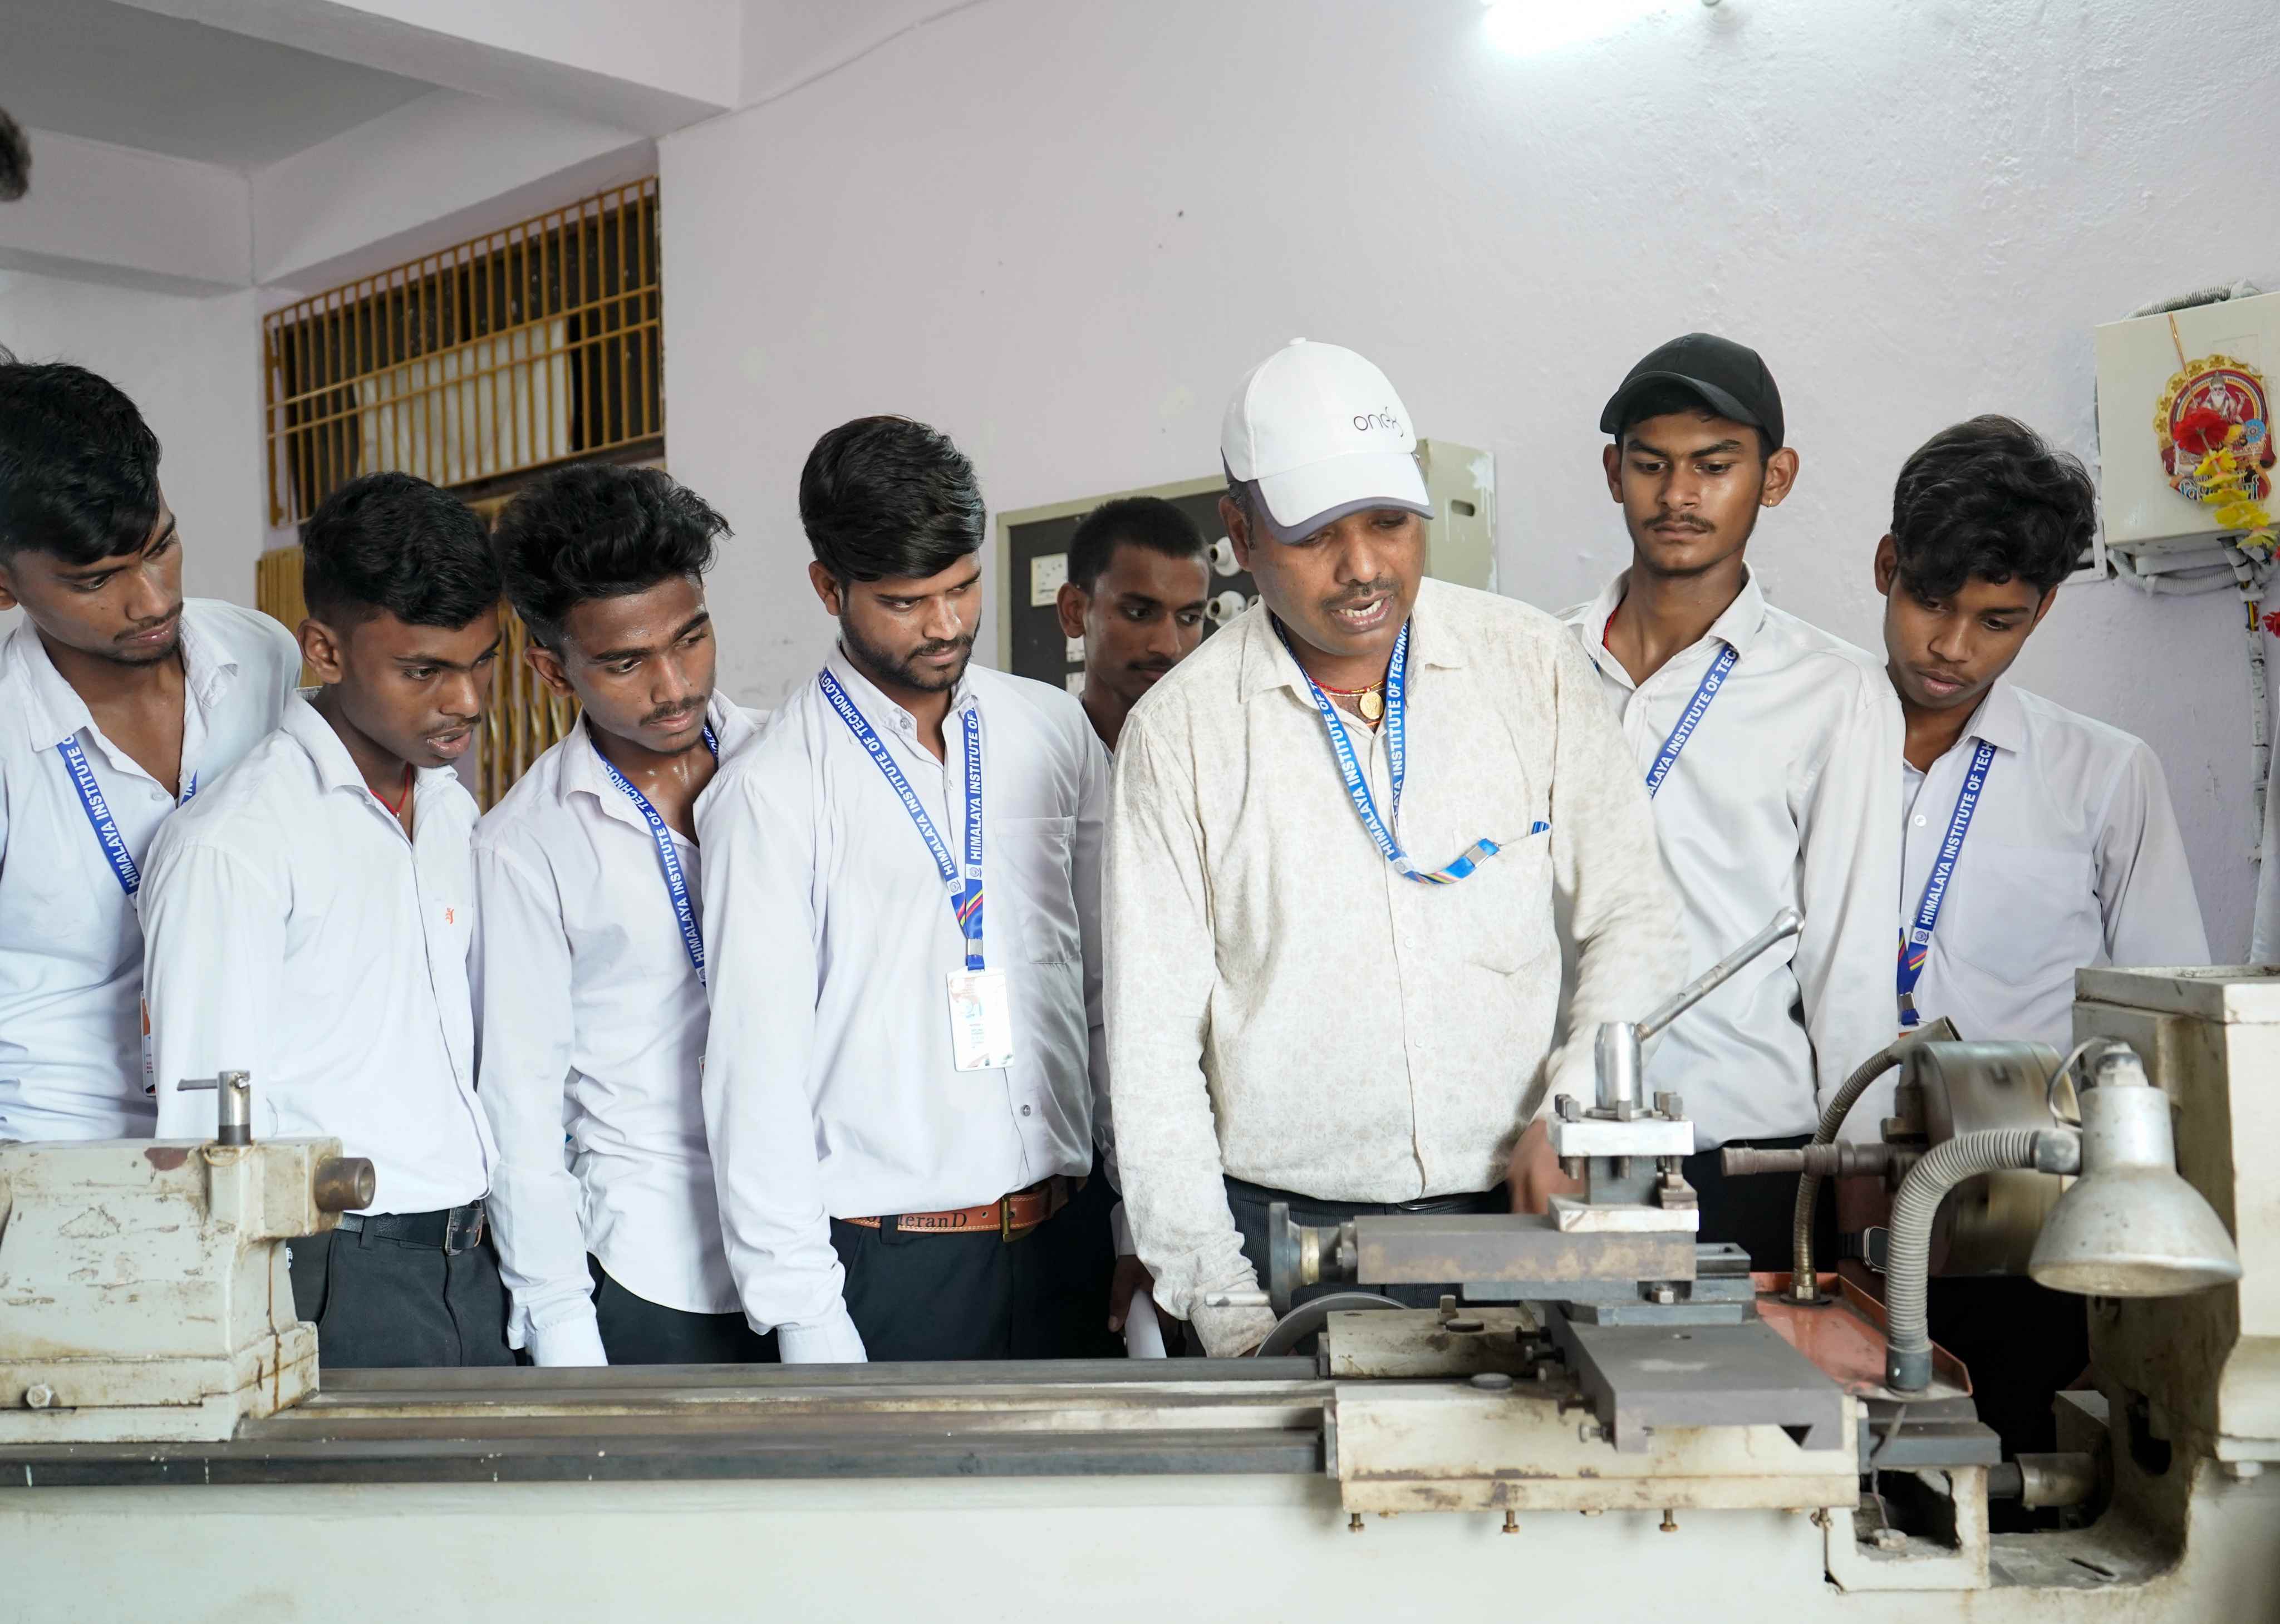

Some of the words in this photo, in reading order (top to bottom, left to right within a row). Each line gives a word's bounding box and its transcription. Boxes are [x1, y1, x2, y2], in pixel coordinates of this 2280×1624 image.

[967, 713, 978, 729] OF
[1314, 693, 1329, 710] OF
[1388, 681, 1401, 698] OF
[1667, 692, 1711, 755] INSTITUTE
[1706, 673, 1721, 692] OF
[863, 736, 880, 752] OF
[968, 731, 981, 796] INSTITUTE
[1325, 713, 1361, 785] INSTITUTE
[1388, 700, 1403, 776] INSTITUTE
[67, 746, 110, 820] INSTITUTE
[875, 751, 921, 814] INSTITUTE
[646, 811, 661, 825] OF
[916, 813, 955, 875] HIMALAYA
[970, 798, 982, 860] HIMALAYA
[1353, 786, 1394, 855] HIMALAYA
[1920, 862, 1952, 925] HIMALAYA
[1944, 793, 1976, 860] INSTITUTE
[1968, 774, 1982, 791] OF
[101, 821, 140, 888] HIMALAYA
[656, 827, 685, 895] INSTITUTE
[677, 897, 704, 962] HIMALAYA
